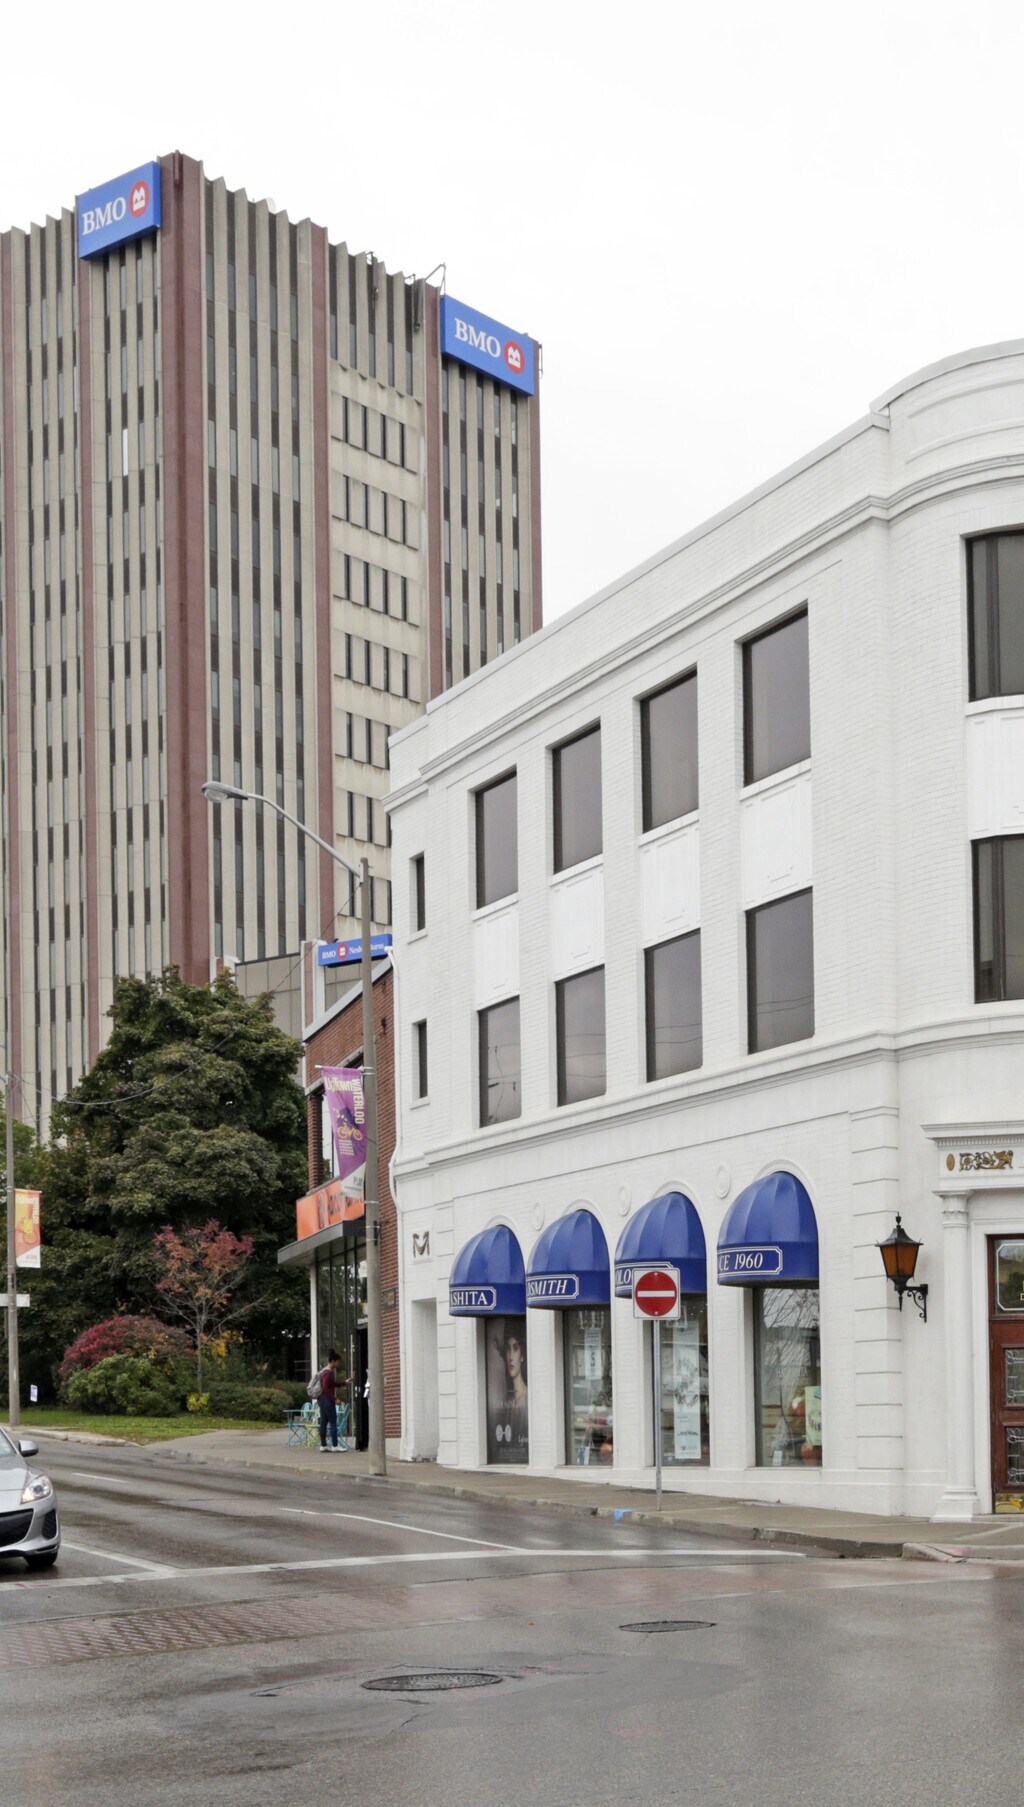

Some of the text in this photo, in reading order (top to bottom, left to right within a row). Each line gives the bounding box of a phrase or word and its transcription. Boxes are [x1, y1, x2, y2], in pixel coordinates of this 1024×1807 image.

[82, 196, 126, 235] BMO
[454, 317, 501, 358] BMO
[322, 950, 336, 959] BMO
[351, 1079, 365, 1124] WATERLOO
[734, 1252, 763, 1270] 1960
